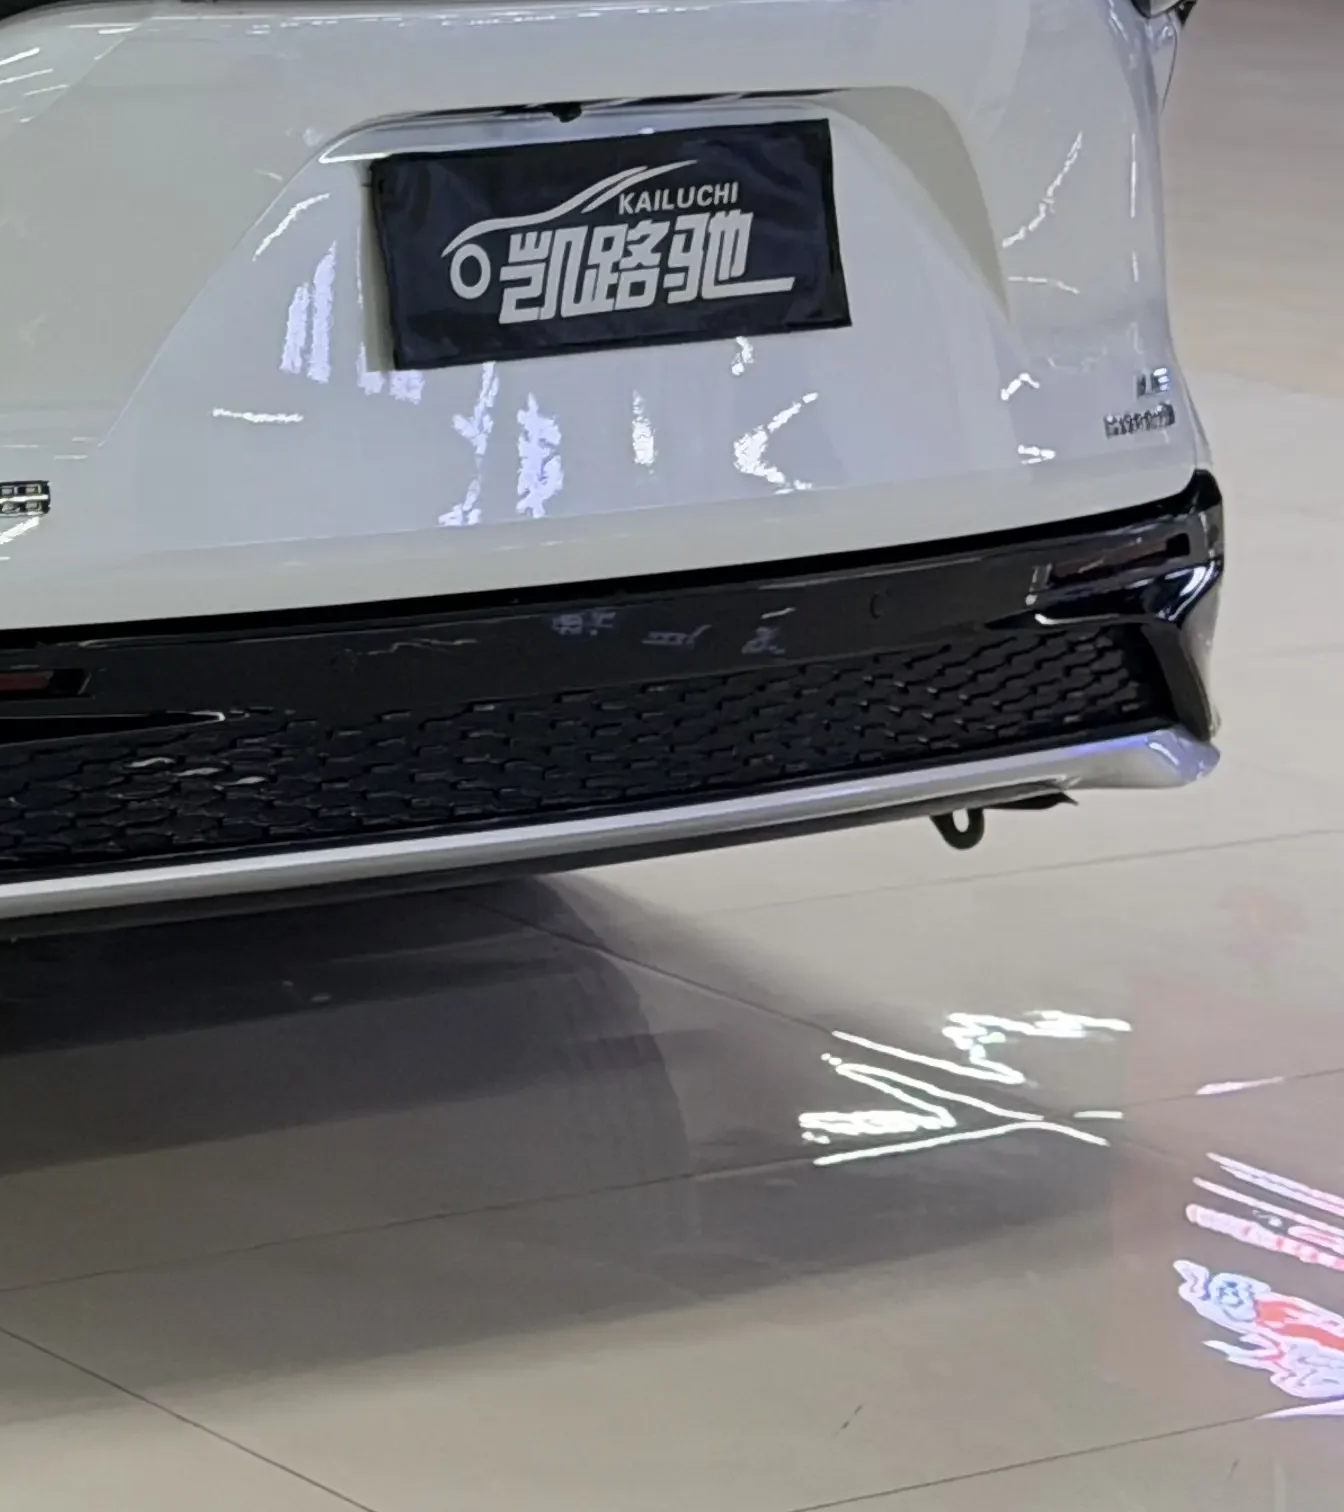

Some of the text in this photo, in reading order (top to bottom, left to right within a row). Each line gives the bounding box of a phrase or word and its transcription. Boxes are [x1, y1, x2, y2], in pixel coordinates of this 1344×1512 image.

[618, 181, 739, 215] KAILUCHI
[498, 209, 796, 325] 凯路驰
